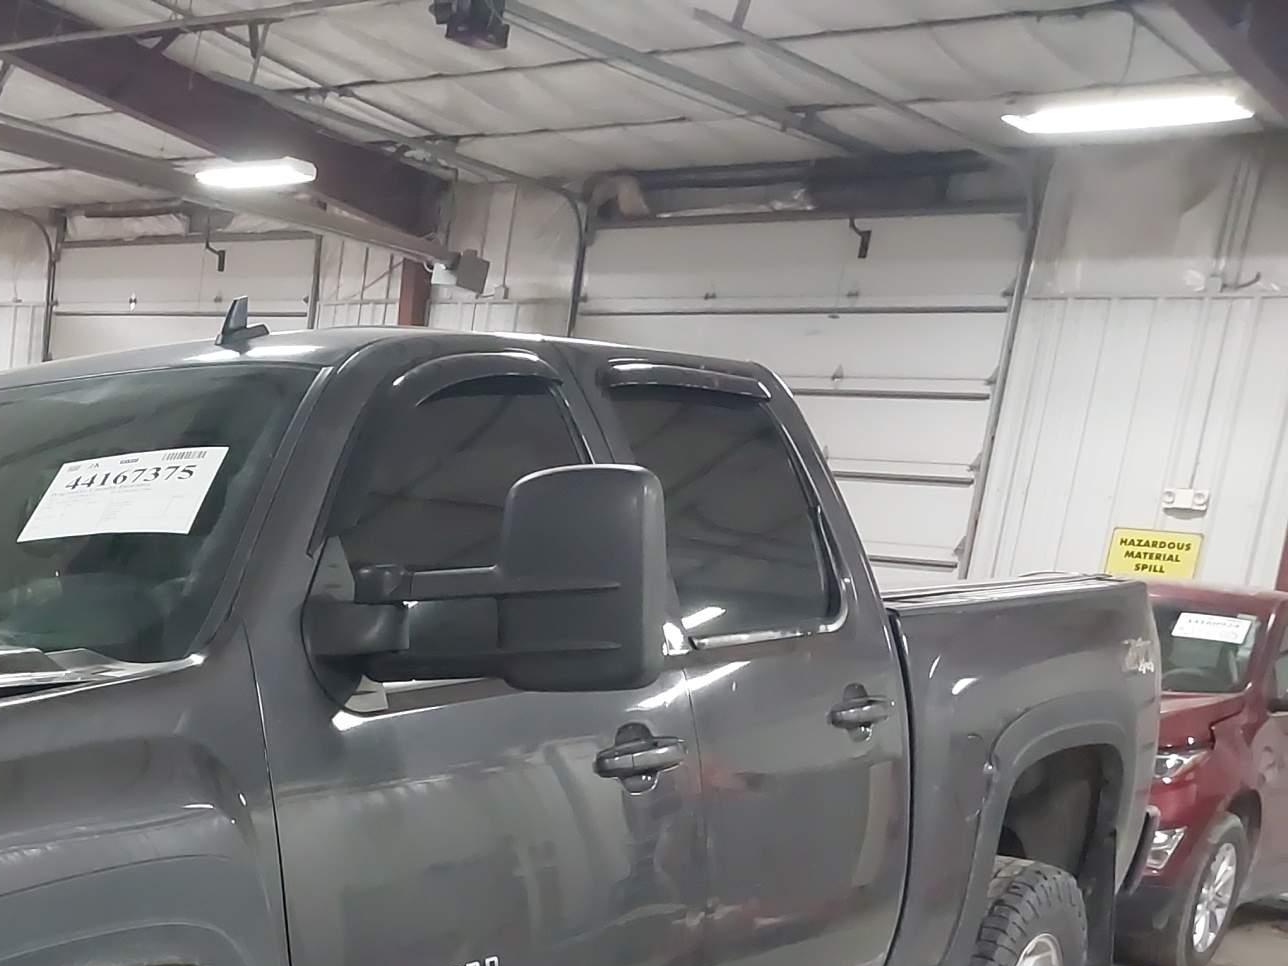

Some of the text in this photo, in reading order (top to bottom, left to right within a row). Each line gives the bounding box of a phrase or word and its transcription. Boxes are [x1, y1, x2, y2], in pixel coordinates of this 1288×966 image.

[65, 464, 197, 490] 44167375
[1119, 538, 1192, 551] HAZARDOUS
[1124, 551, 1181, 562] MATERIAL
[1134, 563, 1165, 573] SPILL
